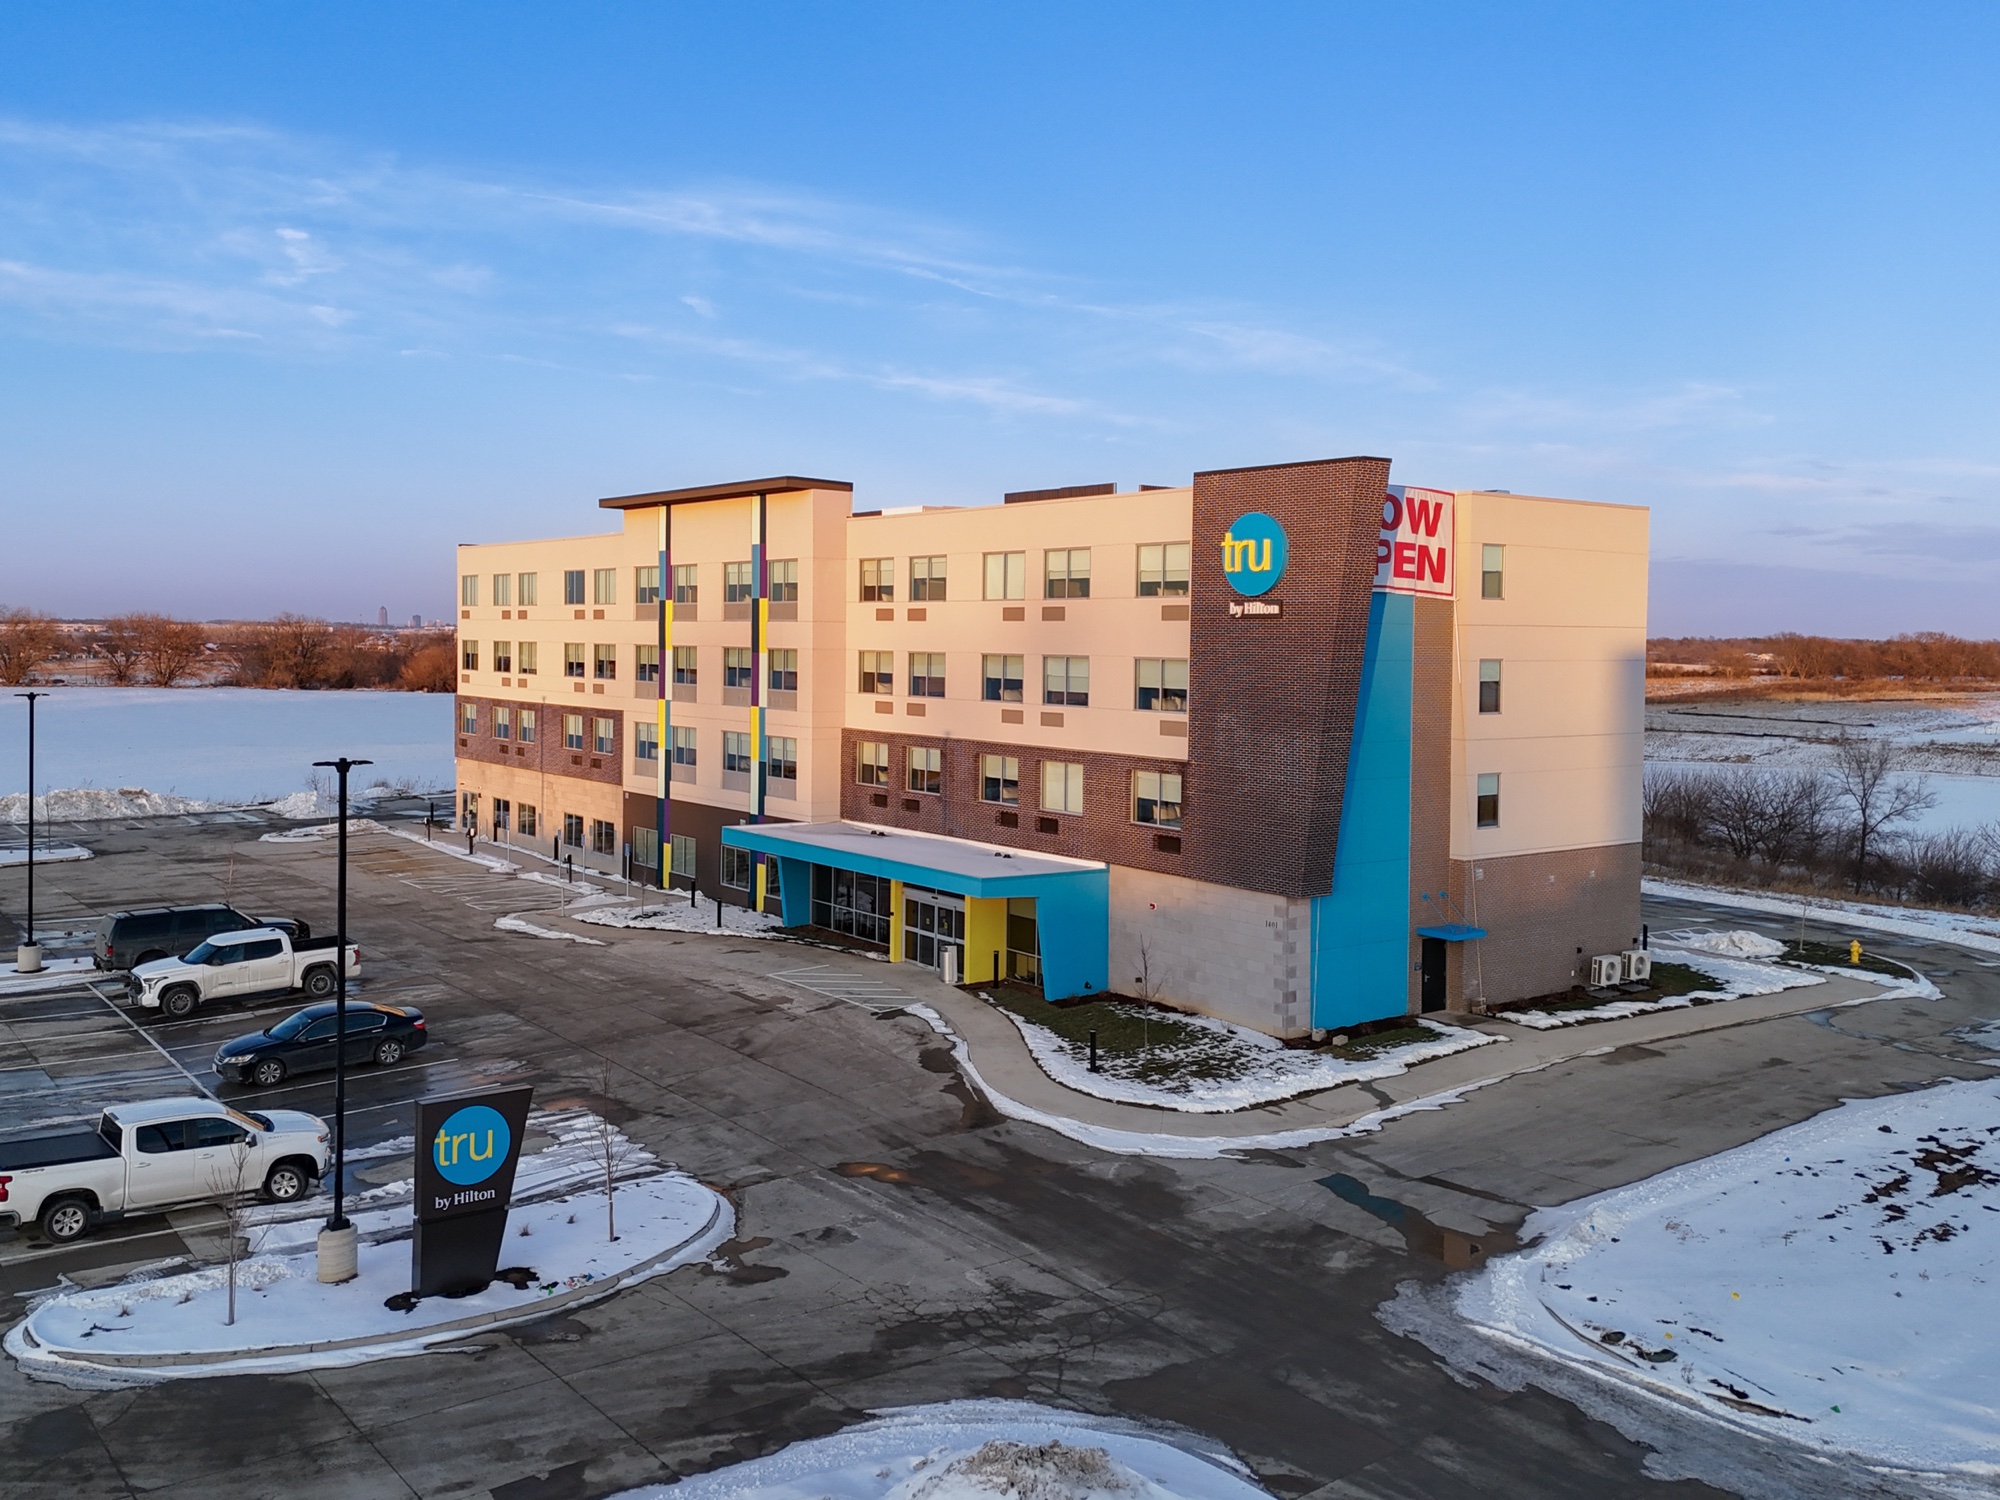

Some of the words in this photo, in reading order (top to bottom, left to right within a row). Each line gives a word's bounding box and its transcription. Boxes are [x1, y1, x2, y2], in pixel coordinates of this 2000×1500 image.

[1381, 493, 1443, 537] OW
[1221, 532, 1271, 573] tru
[1375, 539, 1446, 584] PEN
[1230, 602, 1243, 618] by
[1244, 601, 1280, 614] Hilton
[435, 1129, 494, 1167] tru
[434, 1197, 451, 1210] by
[454, 1189, 496, 1205] Hilton
